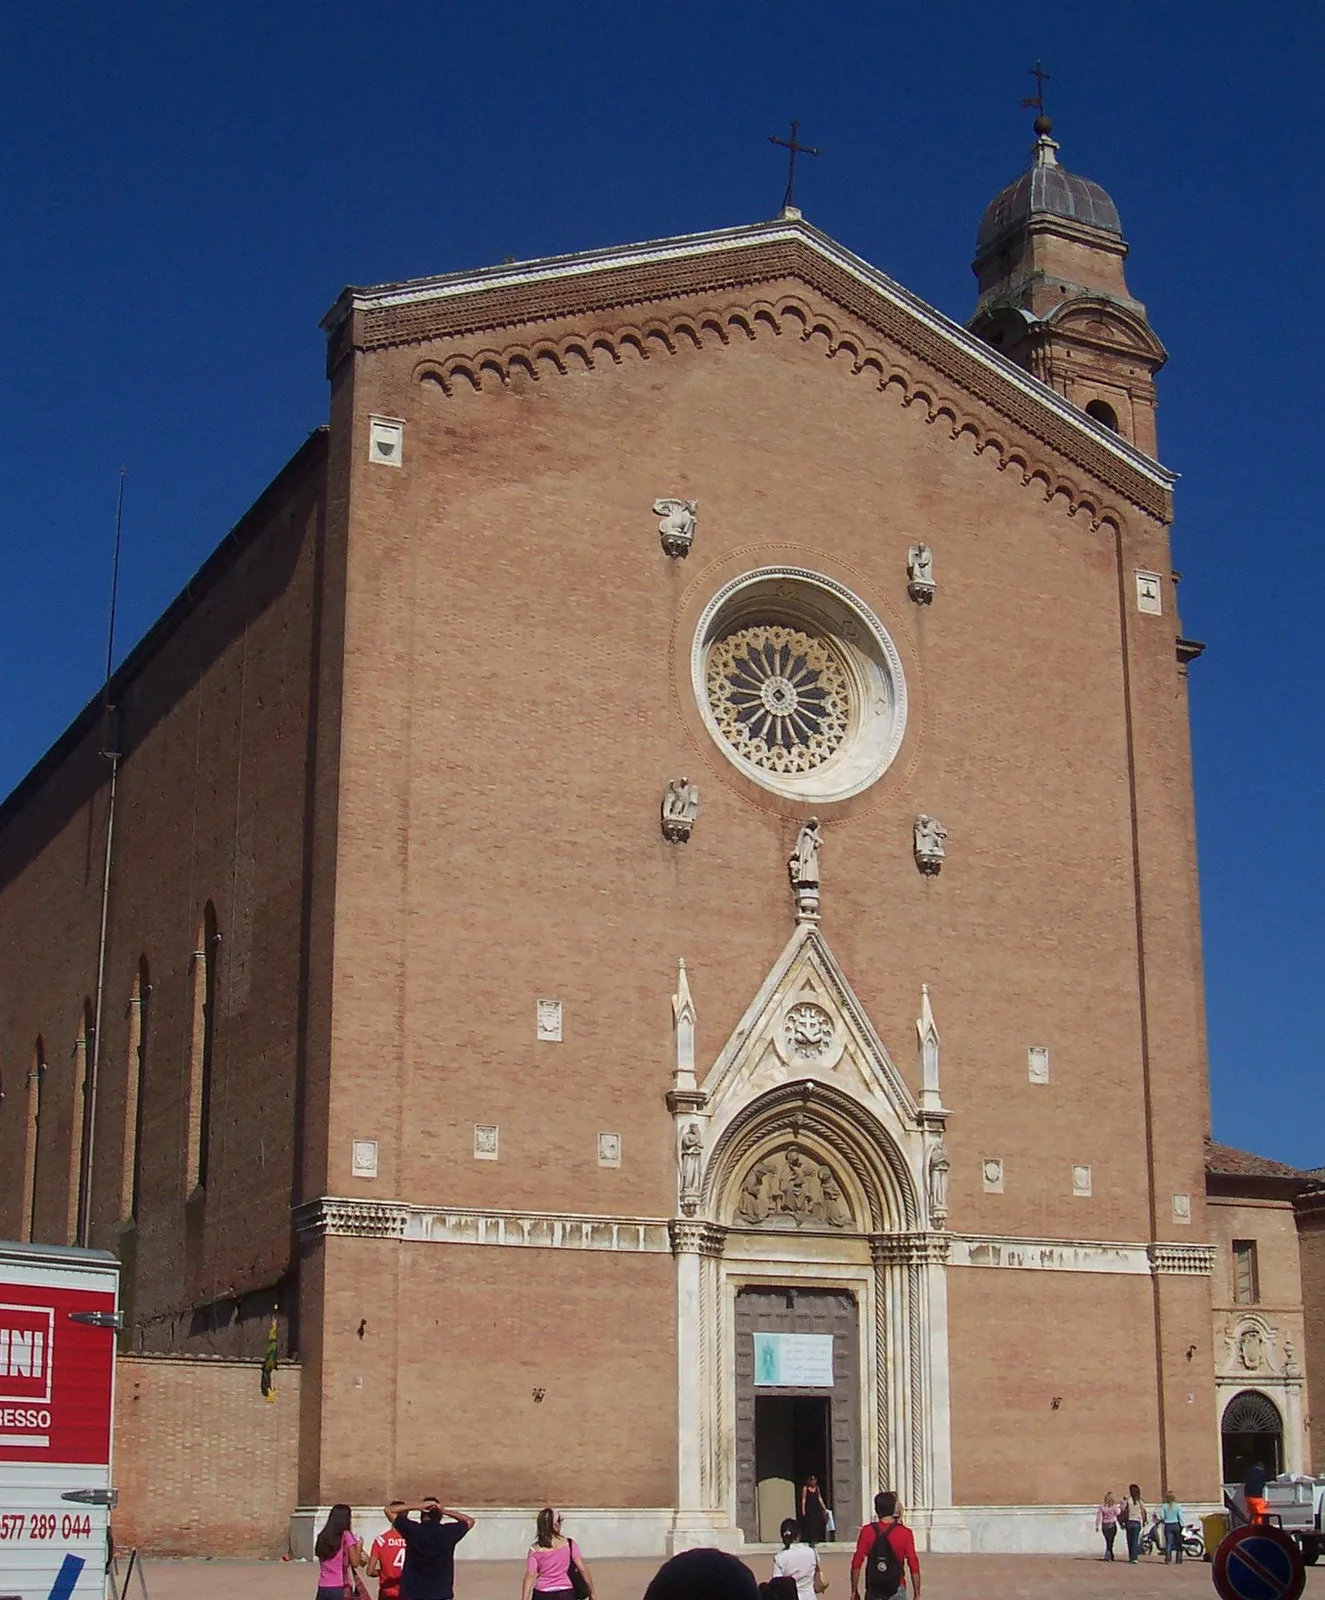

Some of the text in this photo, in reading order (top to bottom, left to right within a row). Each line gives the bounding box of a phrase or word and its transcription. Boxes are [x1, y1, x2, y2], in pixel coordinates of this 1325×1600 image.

[0, 1409, 51, 1427] ESSO
[0, 1514, 91, 1539] 577 289 044
